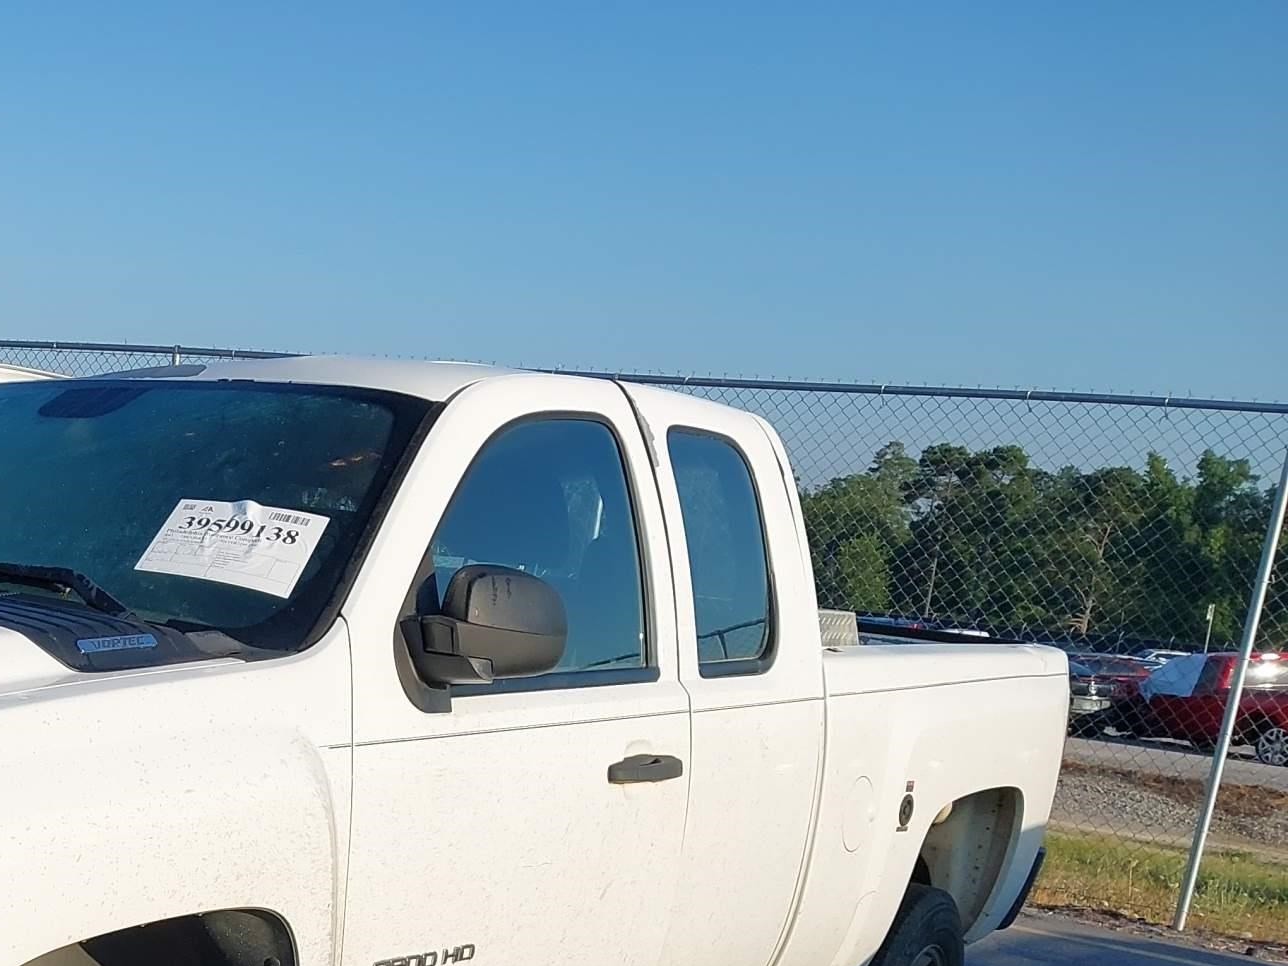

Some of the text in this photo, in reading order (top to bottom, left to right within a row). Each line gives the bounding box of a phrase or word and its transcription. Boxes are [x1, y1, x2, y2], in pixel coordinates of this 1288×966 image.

[178, 514, 300, 545] 39599138
[90, 636, 145, 650] VORTEC
[441, 943, 476, 966] HD
